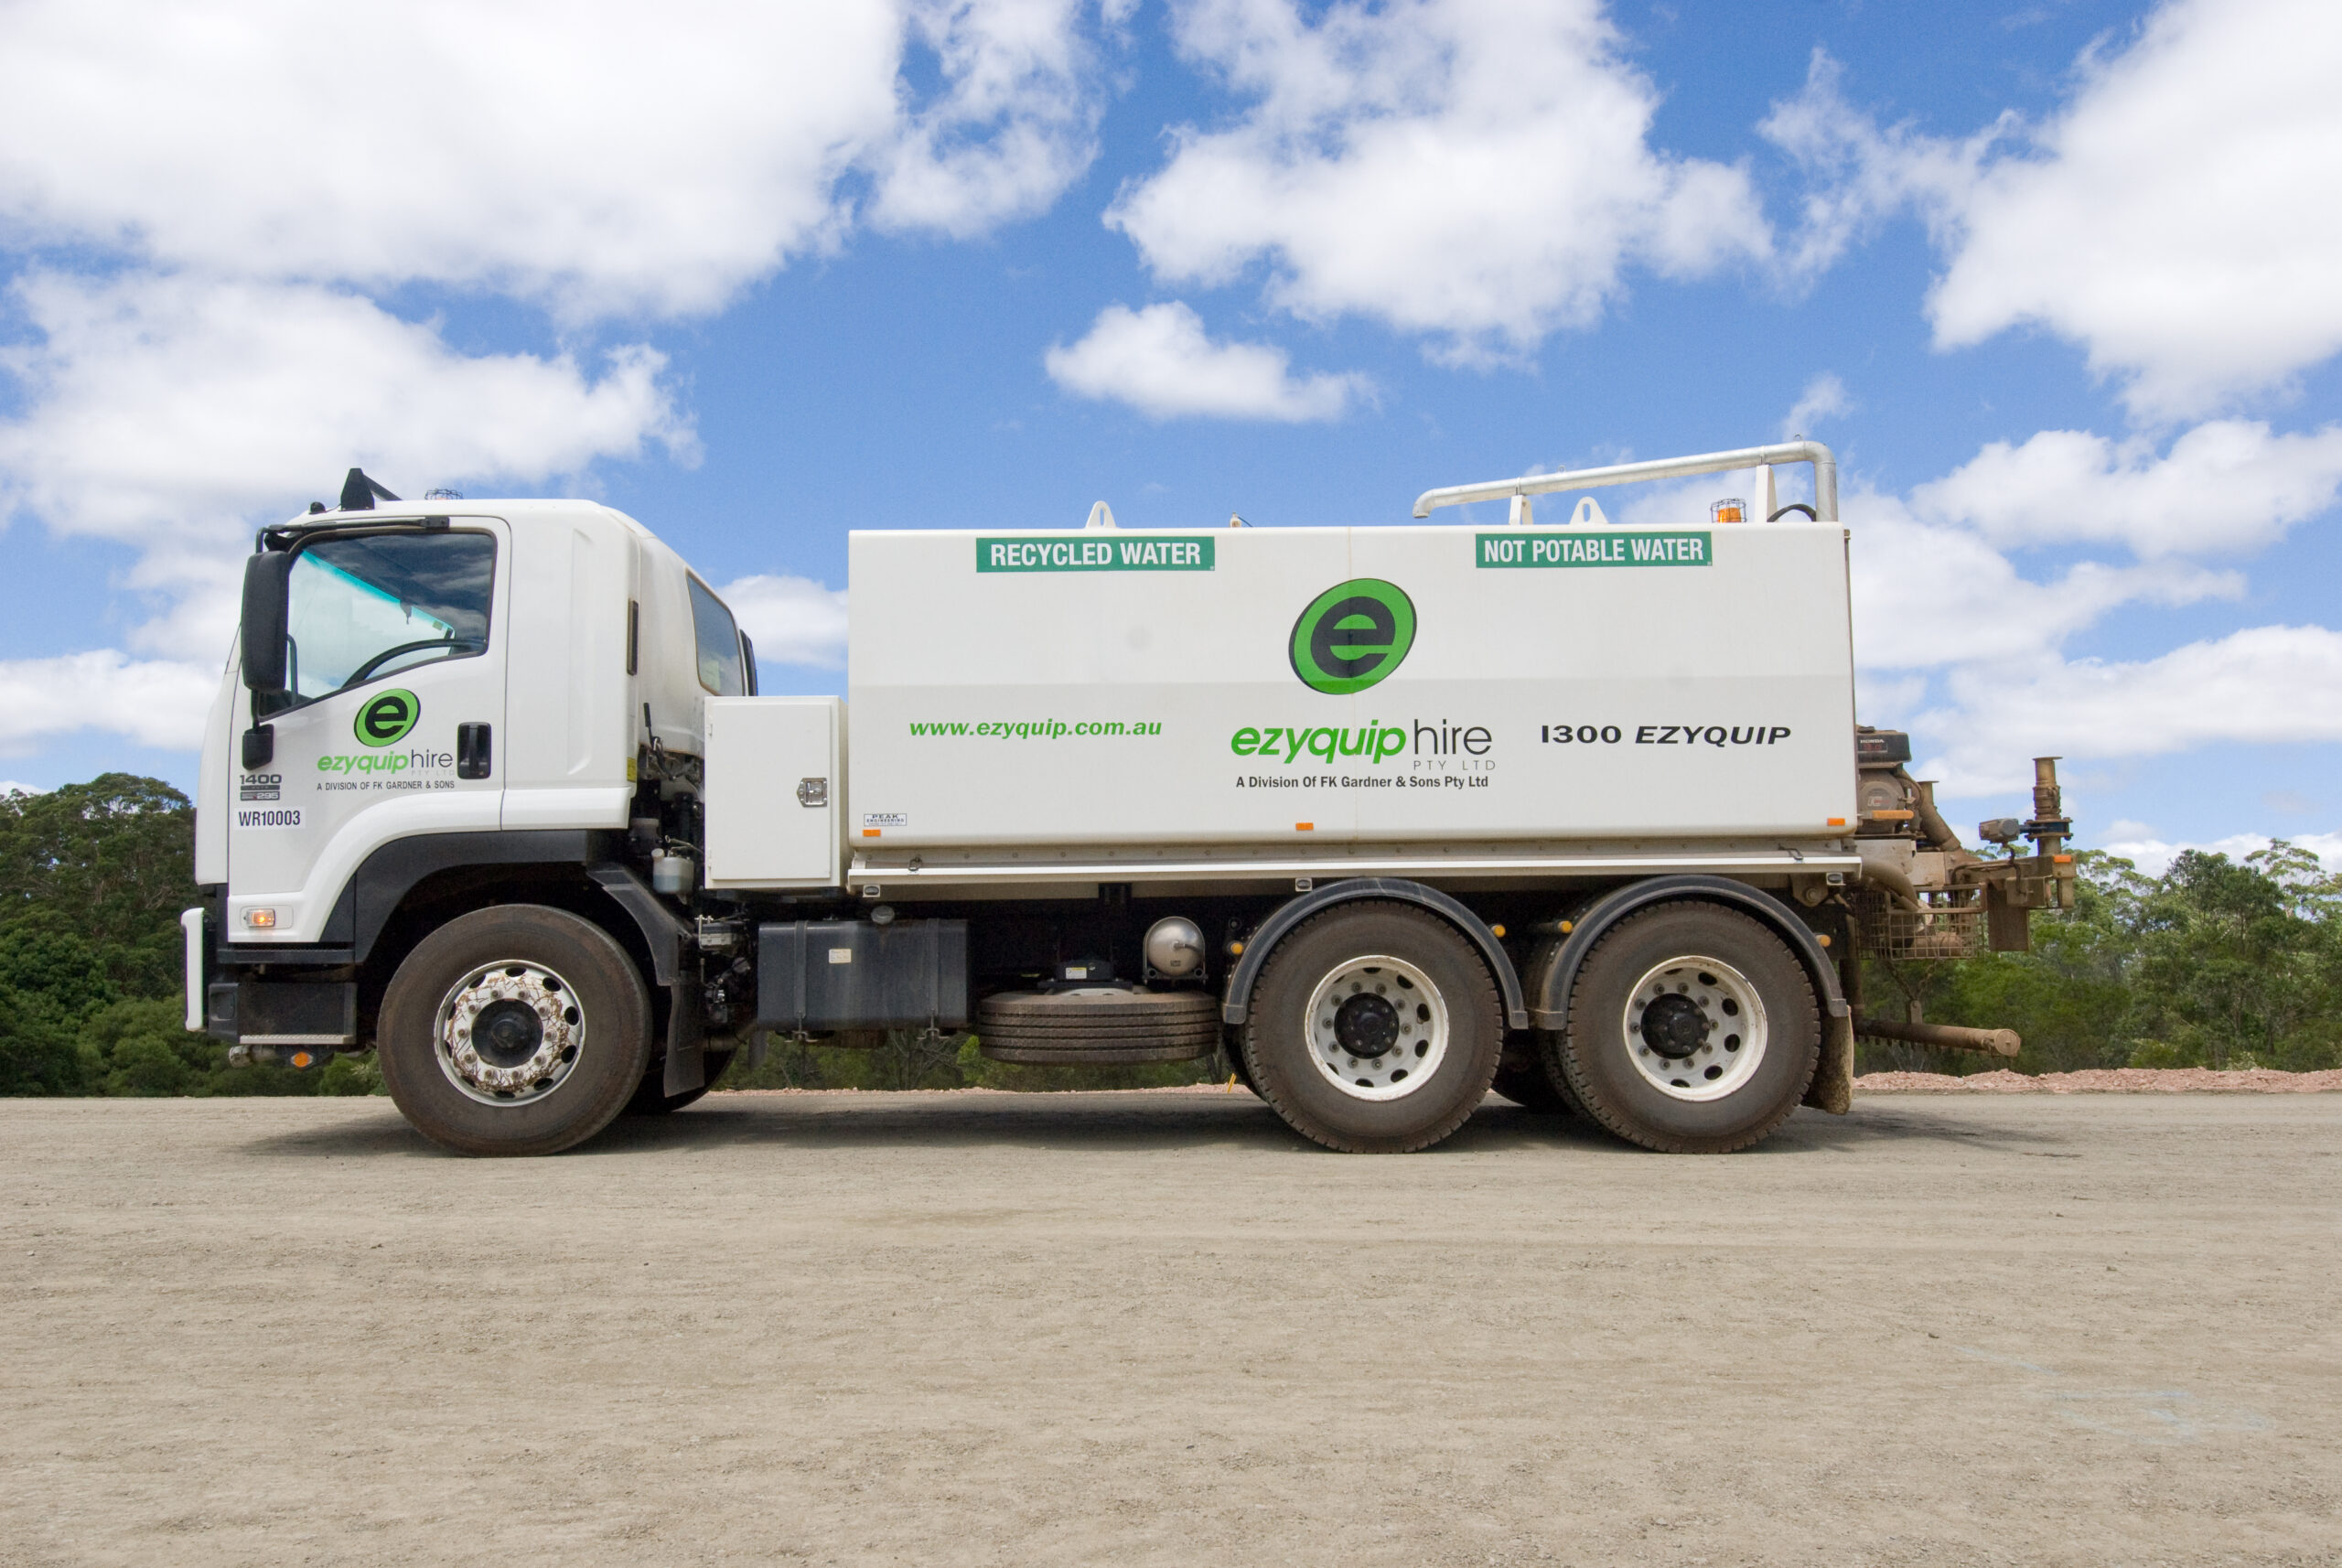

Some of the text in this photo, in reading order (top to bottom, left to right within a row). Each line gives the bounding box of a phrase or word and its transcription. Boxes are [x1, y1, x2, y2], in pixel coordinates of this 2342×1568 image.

[991, 542, 1201, 566] RECYCLED WATER
[1485, 538, 1703, 563] NOT POTABLE WATER
[1310, 596, 1396, 678] e
[364, 695, 409, 739] e
[909, 718, 1162, 739] www.ezyquip.com.au
[1635, 725, 1792, 747] EZYQUIP
[1230, 718, 1493, 765] ezyquip hire
[317, 748, 454, 775] ezyquip hire
[1413, 759, 1496, 771] PTY LTD
[240, 774, 282, 784] 1400
[317, 780, 455, 791] A DIVISION OF FK GARDNER & SONS
[1235, 776, 1488, 790] A Division Of FK Gardner & Sons Pty Ltd
[238, 810, 301, 827] WR10003
